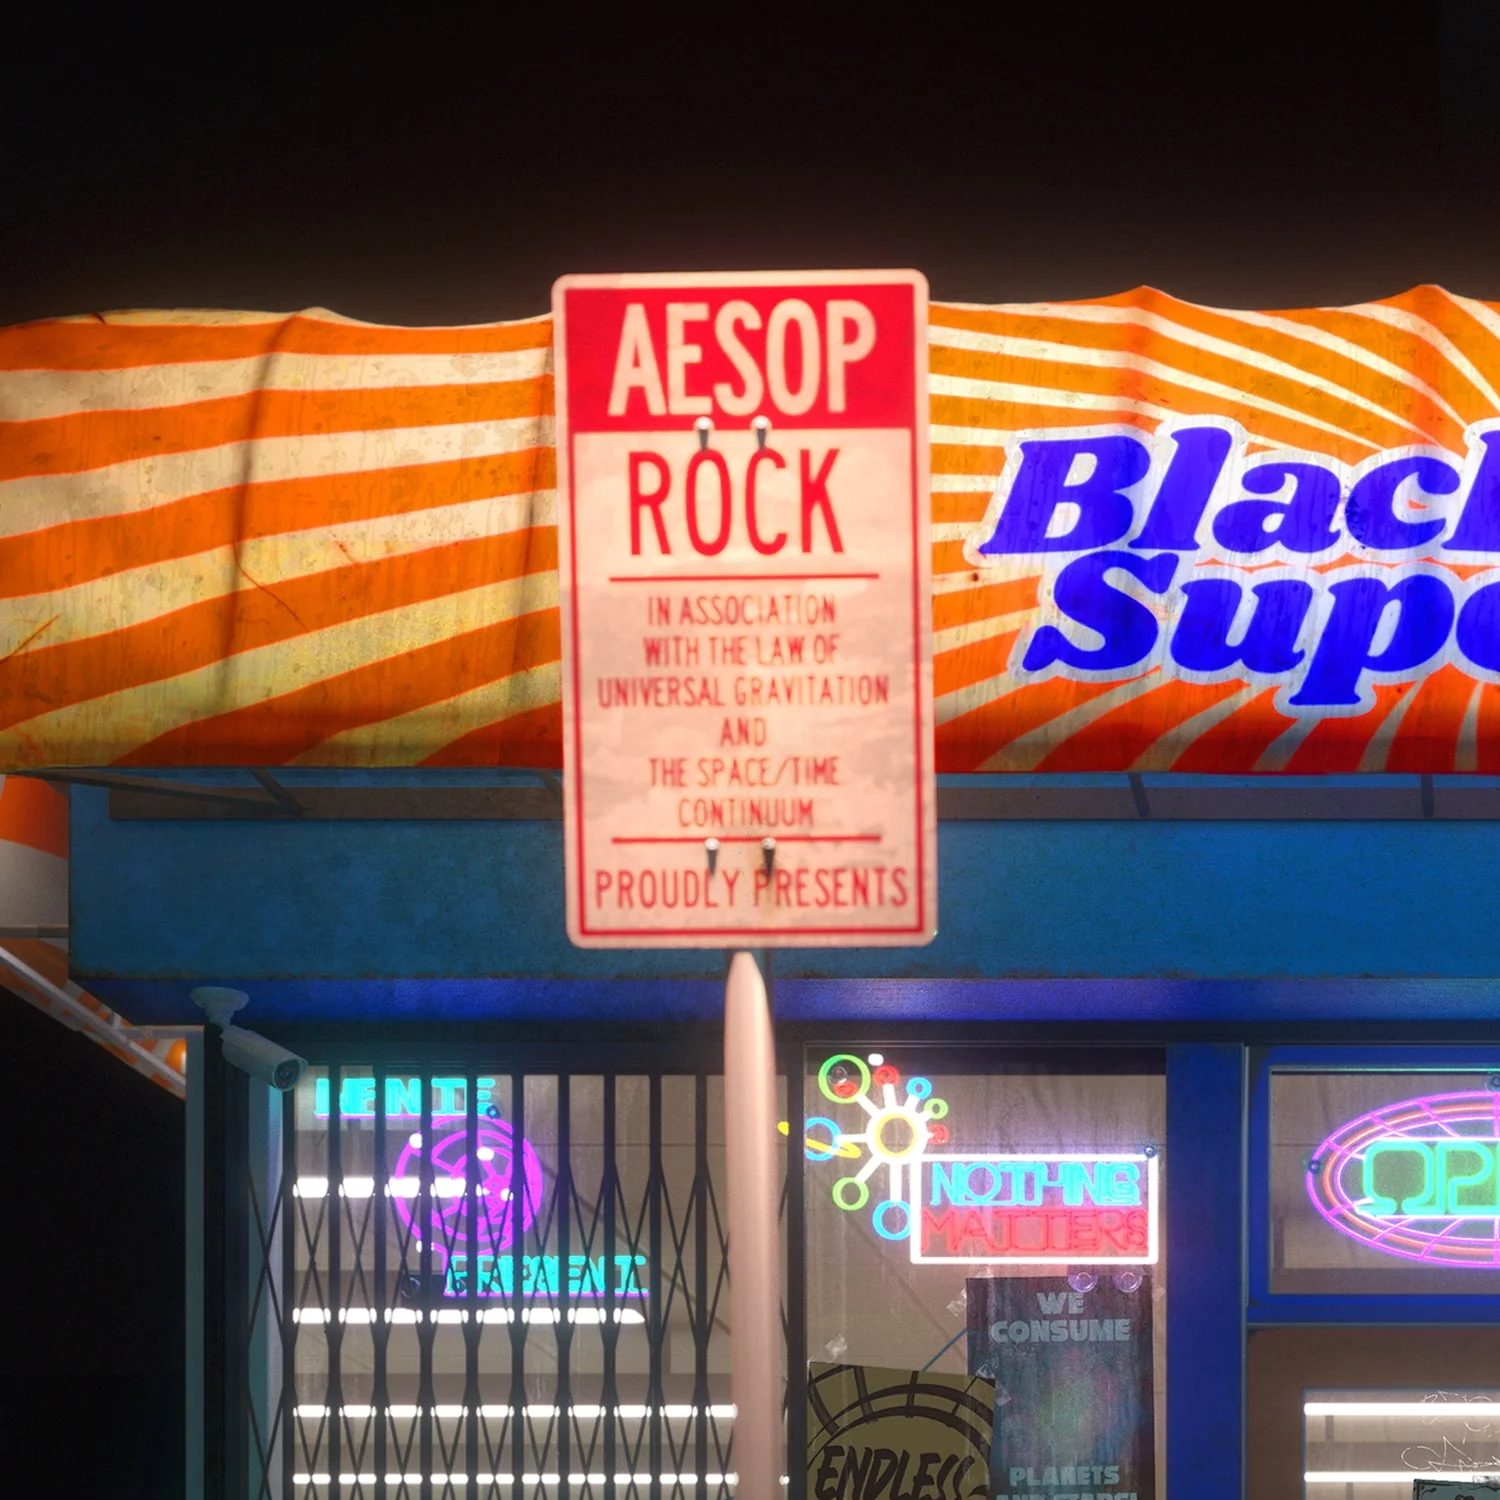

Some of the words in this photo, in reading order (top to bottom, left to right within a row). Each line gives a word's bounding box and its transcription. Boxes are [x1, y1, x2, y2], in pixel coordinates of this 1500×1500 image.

[608, 299, 877, 416] AESOP
[628, 448, 845, 556] ROCK
[648, 596, 671, 627] IN
[680, 594, 836, 627] ASSOCIATION
[643, 636, 701, 667] WITH
[709, 636, 746, 667] THE
[755, 635, 802, 666] LAW
[814, 634, 839, 665] OF
[597, 677, 726, 709] UNIVERSAL
[734, 674, 889, 706] GRAVITATION
[720, 717, 767, 748] AND
[650, 757, 689, 788] THE
[697, 755, 840, 788] SPACE/TIME
[678, 797, 815, 829] CONTINUUM
[595, 869, 738, 911] PROUDLY
[754, 866, 909, 910] PRESENTS
[921, 1209, 1149, 1254] MATTERS
[1036, 1291, 1084, 1316] WE
[990, 1318, 1132, 1344] CONSUME
[1009, 1464, 1121, 1488] PLANETS
